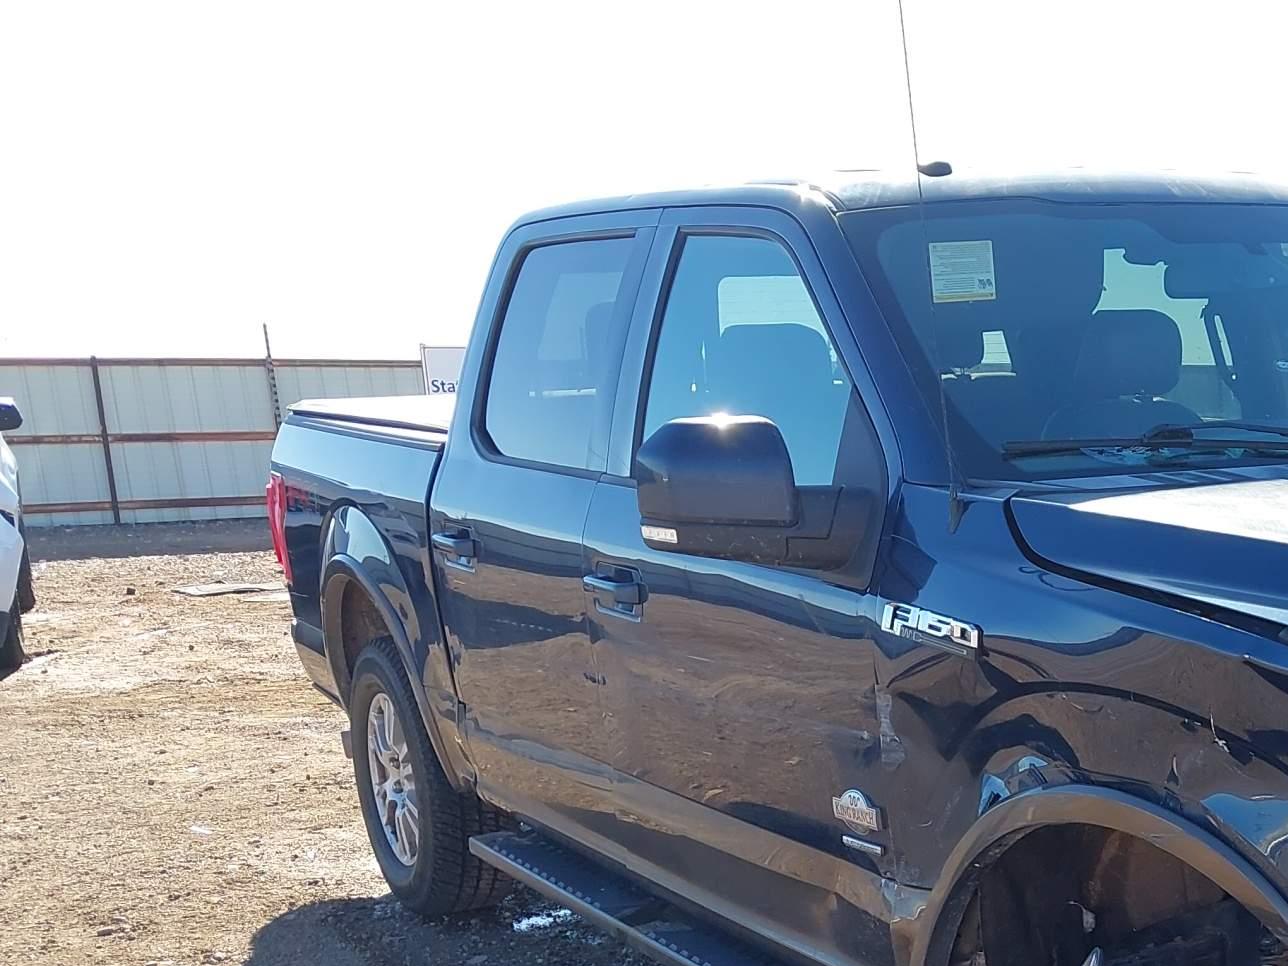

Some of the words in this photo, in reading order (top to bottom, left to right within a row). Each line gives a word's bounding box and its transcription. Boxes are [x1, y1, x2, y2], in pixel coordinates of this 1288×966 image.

[431, 379, 459, 393] Sta
[834, 801, 852, 819] KING
[852, 807, 875, 826] RANCH
